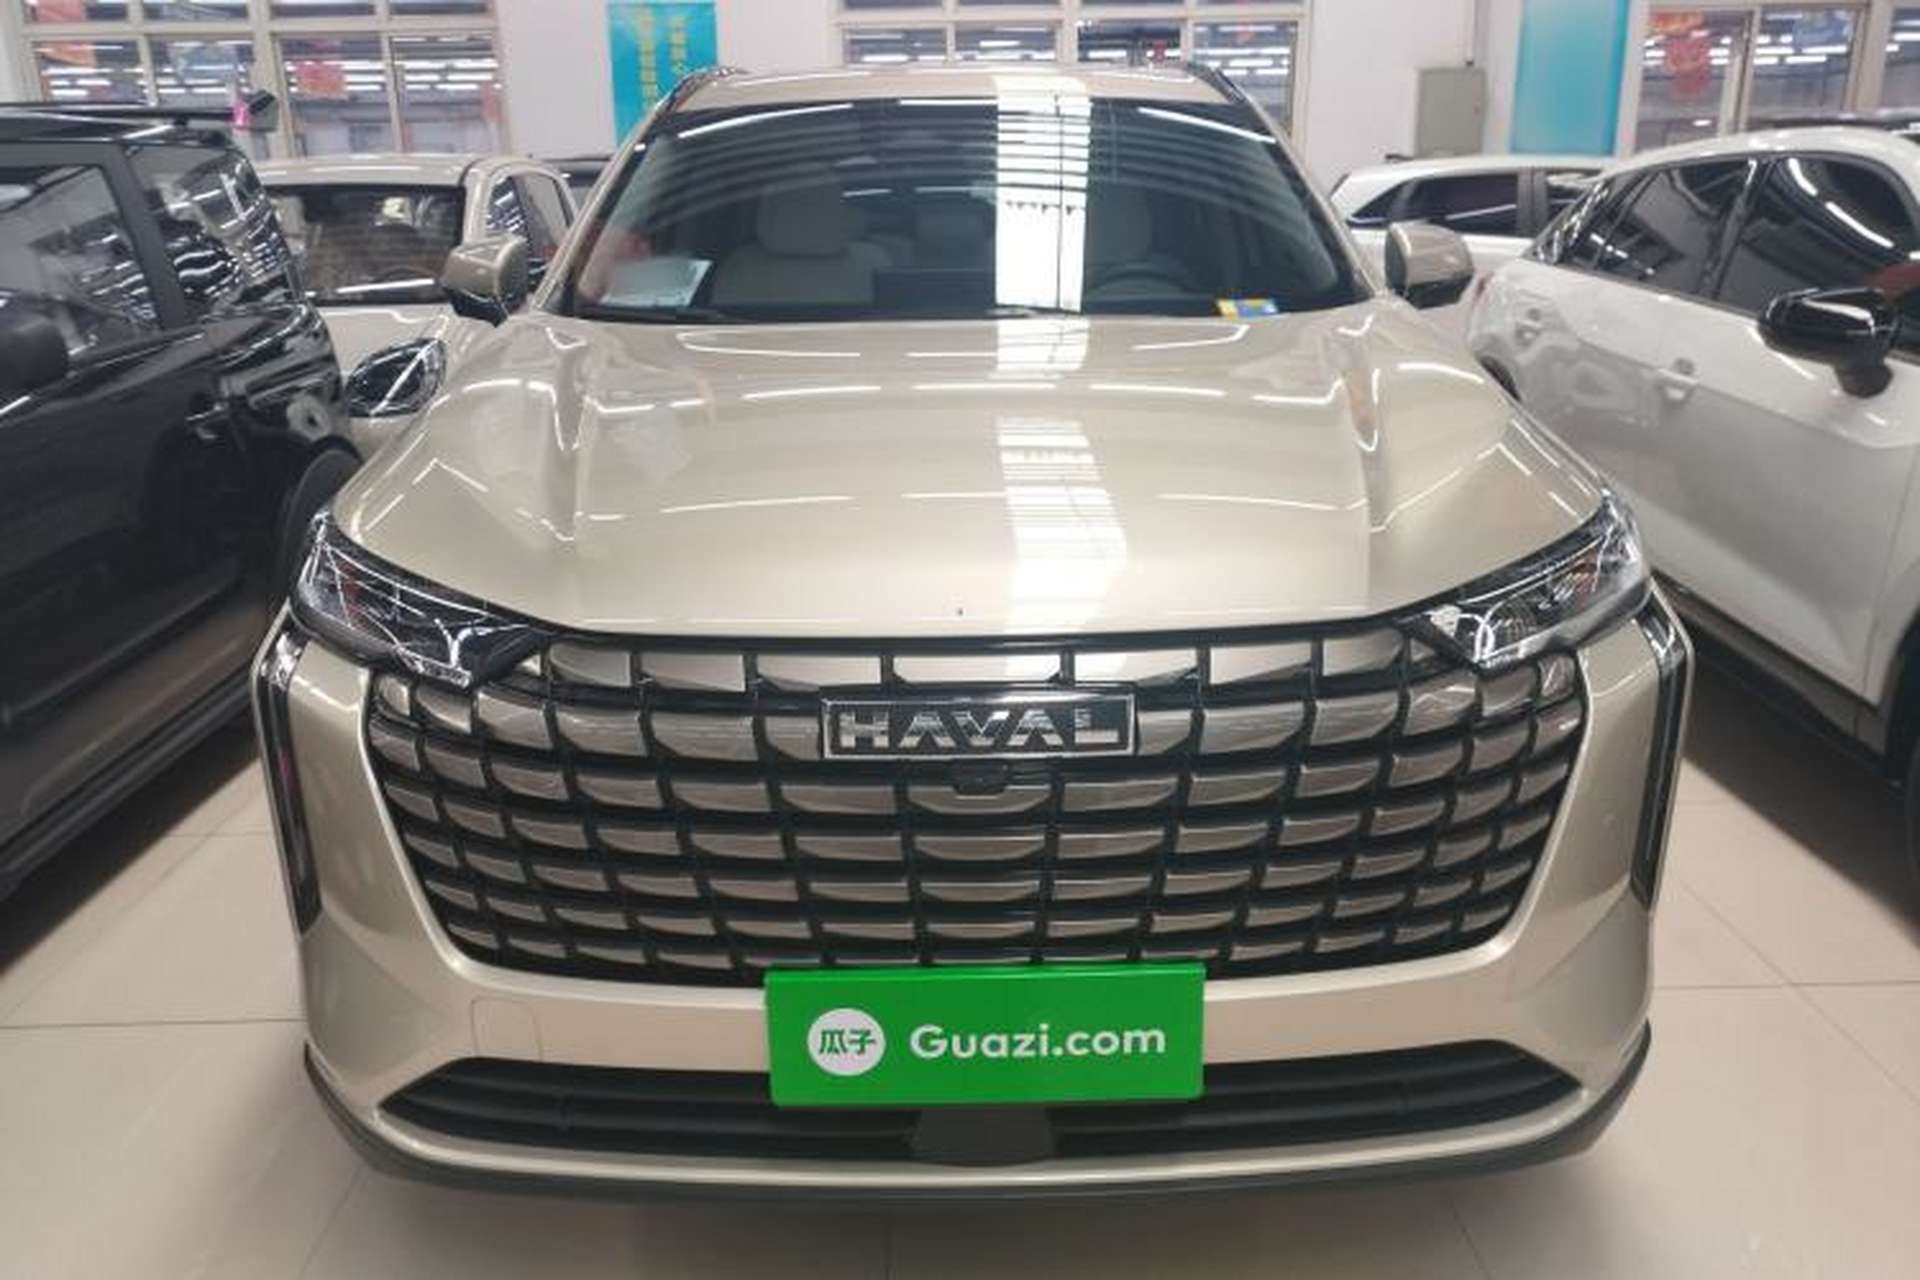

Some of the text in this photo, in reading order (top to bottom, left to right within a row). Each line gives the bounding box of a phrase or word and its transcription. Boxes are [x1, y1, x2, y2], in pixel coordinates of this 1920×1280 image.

[839, 708, 1120, 749] HAVAL
[818, 1028, 877, 1056] 瓜子
[909, 1023, 1166, 1059] Guazi.com
